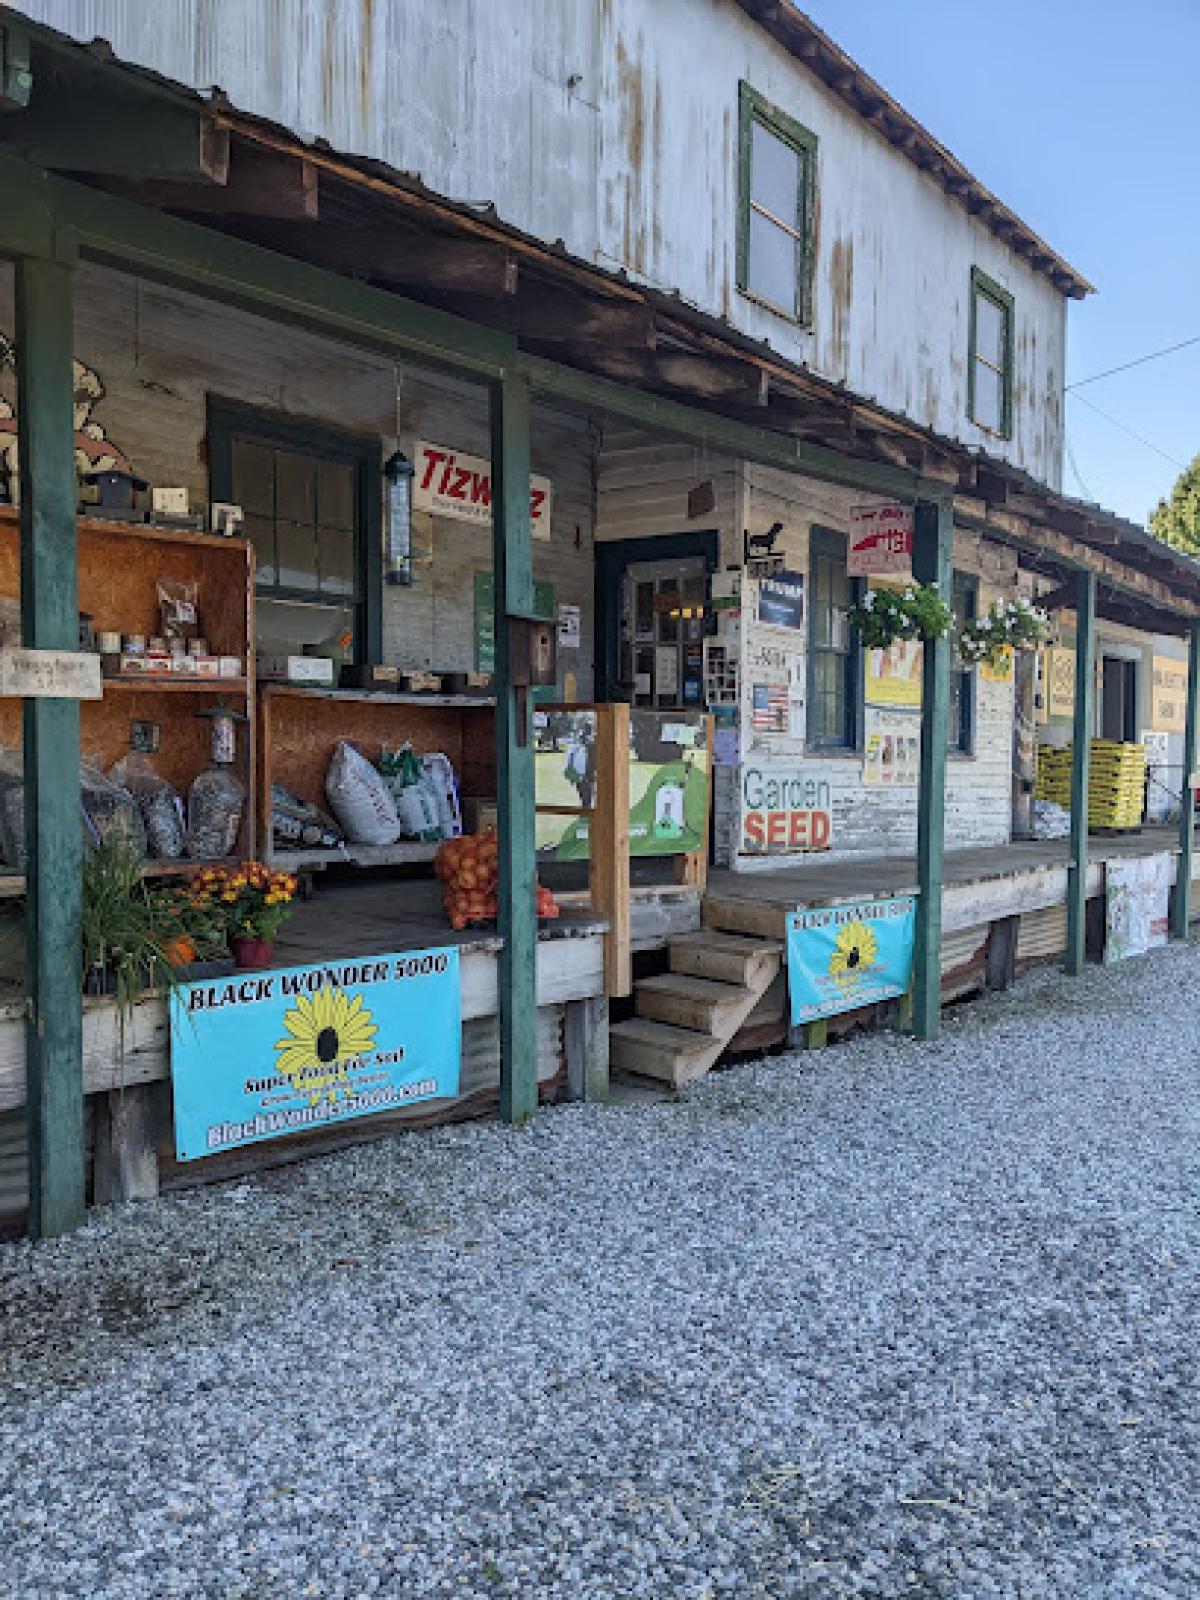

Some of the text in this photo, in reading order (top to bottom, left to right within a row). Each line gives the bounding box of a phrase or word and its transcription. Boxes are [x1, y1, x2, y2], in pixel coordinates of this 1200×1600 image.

[420, 448, 546, 519] Tizwz
[743, 767, 830, 810] Garden
[744, 811, 830, 851] SEED
[188, 952, 449, 1011] BLACK WONDER 5000
